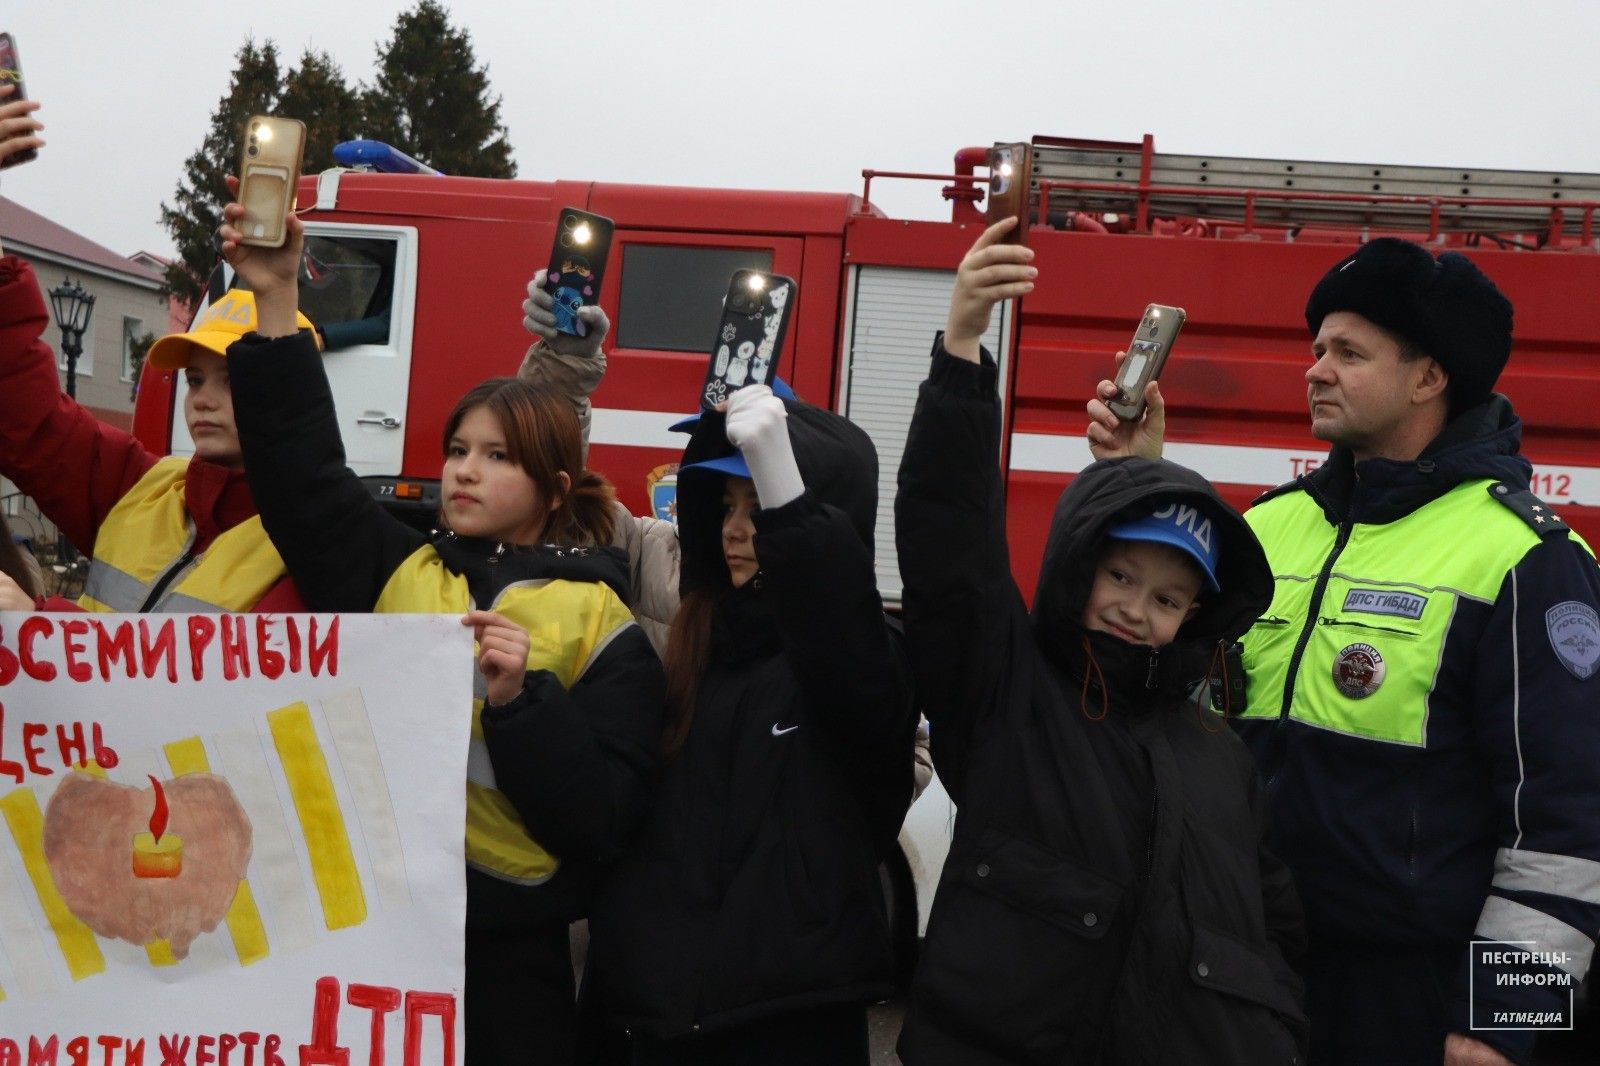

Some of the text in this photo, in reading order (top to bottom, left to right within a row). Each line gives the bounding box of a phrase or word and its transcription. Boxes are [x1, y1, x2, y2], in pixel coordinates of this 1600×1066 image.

[1531, 473, 1571, 496] 112
[1346, 593, 1421, 614] ДПС ГИБДД
[1341, 643, 1383, 664] ПОЛИЦИЯ
[159, 1031, 286, 1066] ЖЕРТВ
[298, 975, 457, 1066] ДТП
